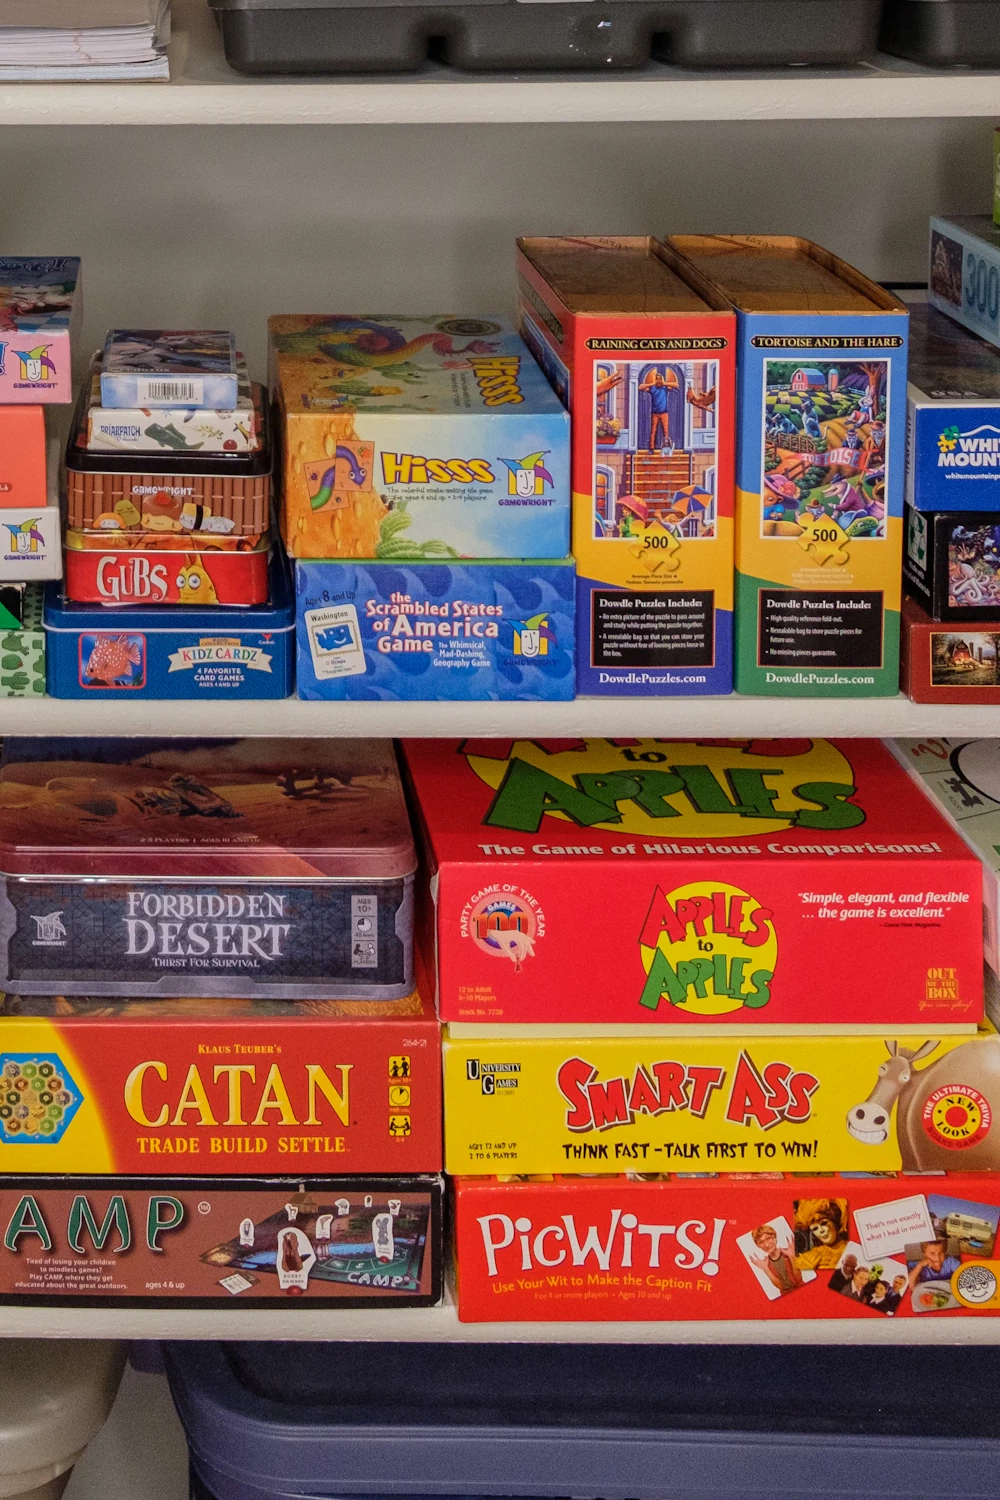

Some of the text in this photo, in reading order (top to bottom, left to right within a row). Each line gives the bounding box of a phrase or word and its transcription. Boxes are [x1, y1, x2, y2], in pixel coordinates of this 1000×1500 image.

[592, 338, 722, 349] RAINING CATS AND DOGS
[757, 337, 898, 347] TORTOISE AND THE HARE
[812, 529, 837, 541] 500
[644, 536, 668, 549] 500
[366, 599, 503, 617] Scrambled States
[600, 599, 702, 608] Dowdle Puzzles Include:
[767, 600, 871, 609] Dowdle Puzzles Include:
[310, 611, 348, 622] Washington
[373, 614, 499, 638] of America
[378, 636, 434, 654] Game
[182, 648, 257, 662] KIDZ CARDZ
[434, 658, 470, 668] Geography
[600, 673, 706, 684] DowdlePuzzles.com
[766, 673, 874, 684] DowdlePuzzles.com
[620, 748, 667, 763] to
[482, 757, 866, 833] APPLES
[477, 841, 942, 856] The Game of Hilarious Comparisons!
[127, 891, 287, 920] FORBIDDEN
[847, 892, 969, 906] elegant, and flexible
[638, 884, 775, 950] APPLES
[818, 907, 874, 921] the game
[122, 918, 291, 961] DESERT
[697, 938, 714, 952] to
[152, 957, 260, 968] THIRST FOR SURVIVAL
[638, 947, 775, 1011] APPLES
[198, 1044, 231, 1054] KLAUS
[123, 1060, 354, 1127] CATAN
[557, 1056, 725, 1133] SMART
[725, 1049, 820, 1131] ASS
[137, 1136, 345, 1153] TRADE BUILD SETTLE
[562, 1140, 819, 1159] THINK FAST FIRST TO WIN!
[899, 1211, 921, 1224] exactly
[90, 1258, 116, 1266] children
[492, 1273, 712, 1294] Use Your Wit to Make the Caption Fit
